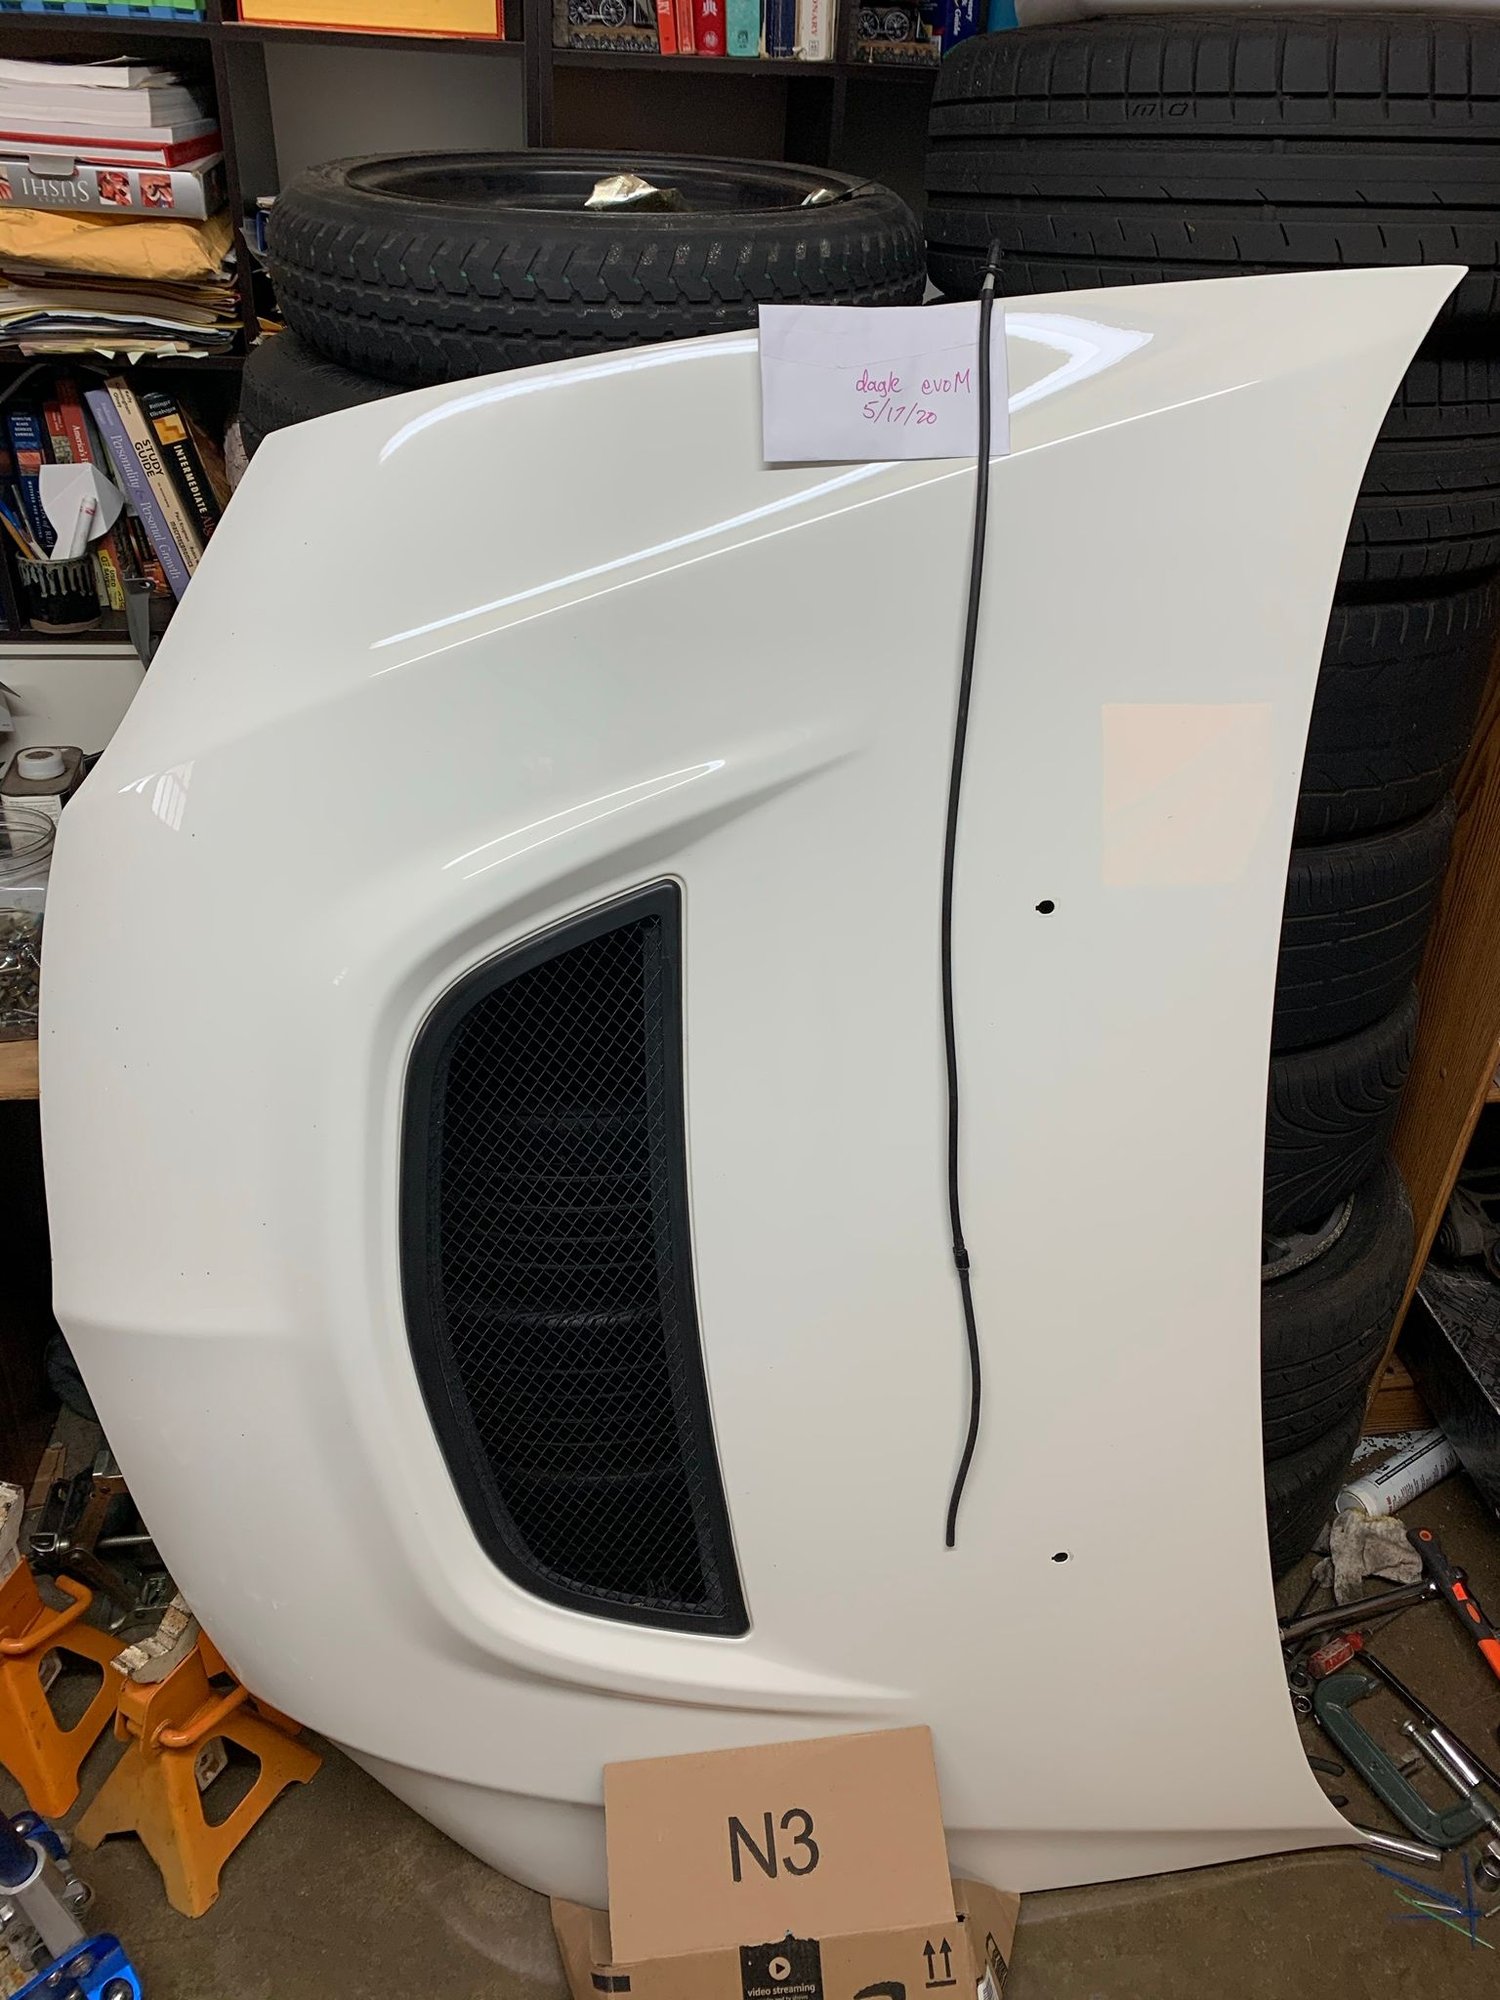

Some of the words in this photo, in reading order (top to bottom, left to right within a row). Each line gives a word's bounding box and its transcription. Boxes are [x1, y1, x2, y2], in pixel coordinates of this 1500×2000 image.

[21, 177, 90, 203] SUSHI
[862, 398, 938, 426] 5/17/20
[133, 441, 156, 478] GUIDE
[141, 439, 165, 476] STUDY
[172, 444, 208, 514] INTERMEDIATE
[110, 433, 141, 490] Personality
[140, 500, 167, 543] Personal
[158, 543, 182, 580] Growth
[728, 1807, 821, 1883] N3
[747, 1987, 772, 1997] video
[772, 1982, 816, 1995] streaming
